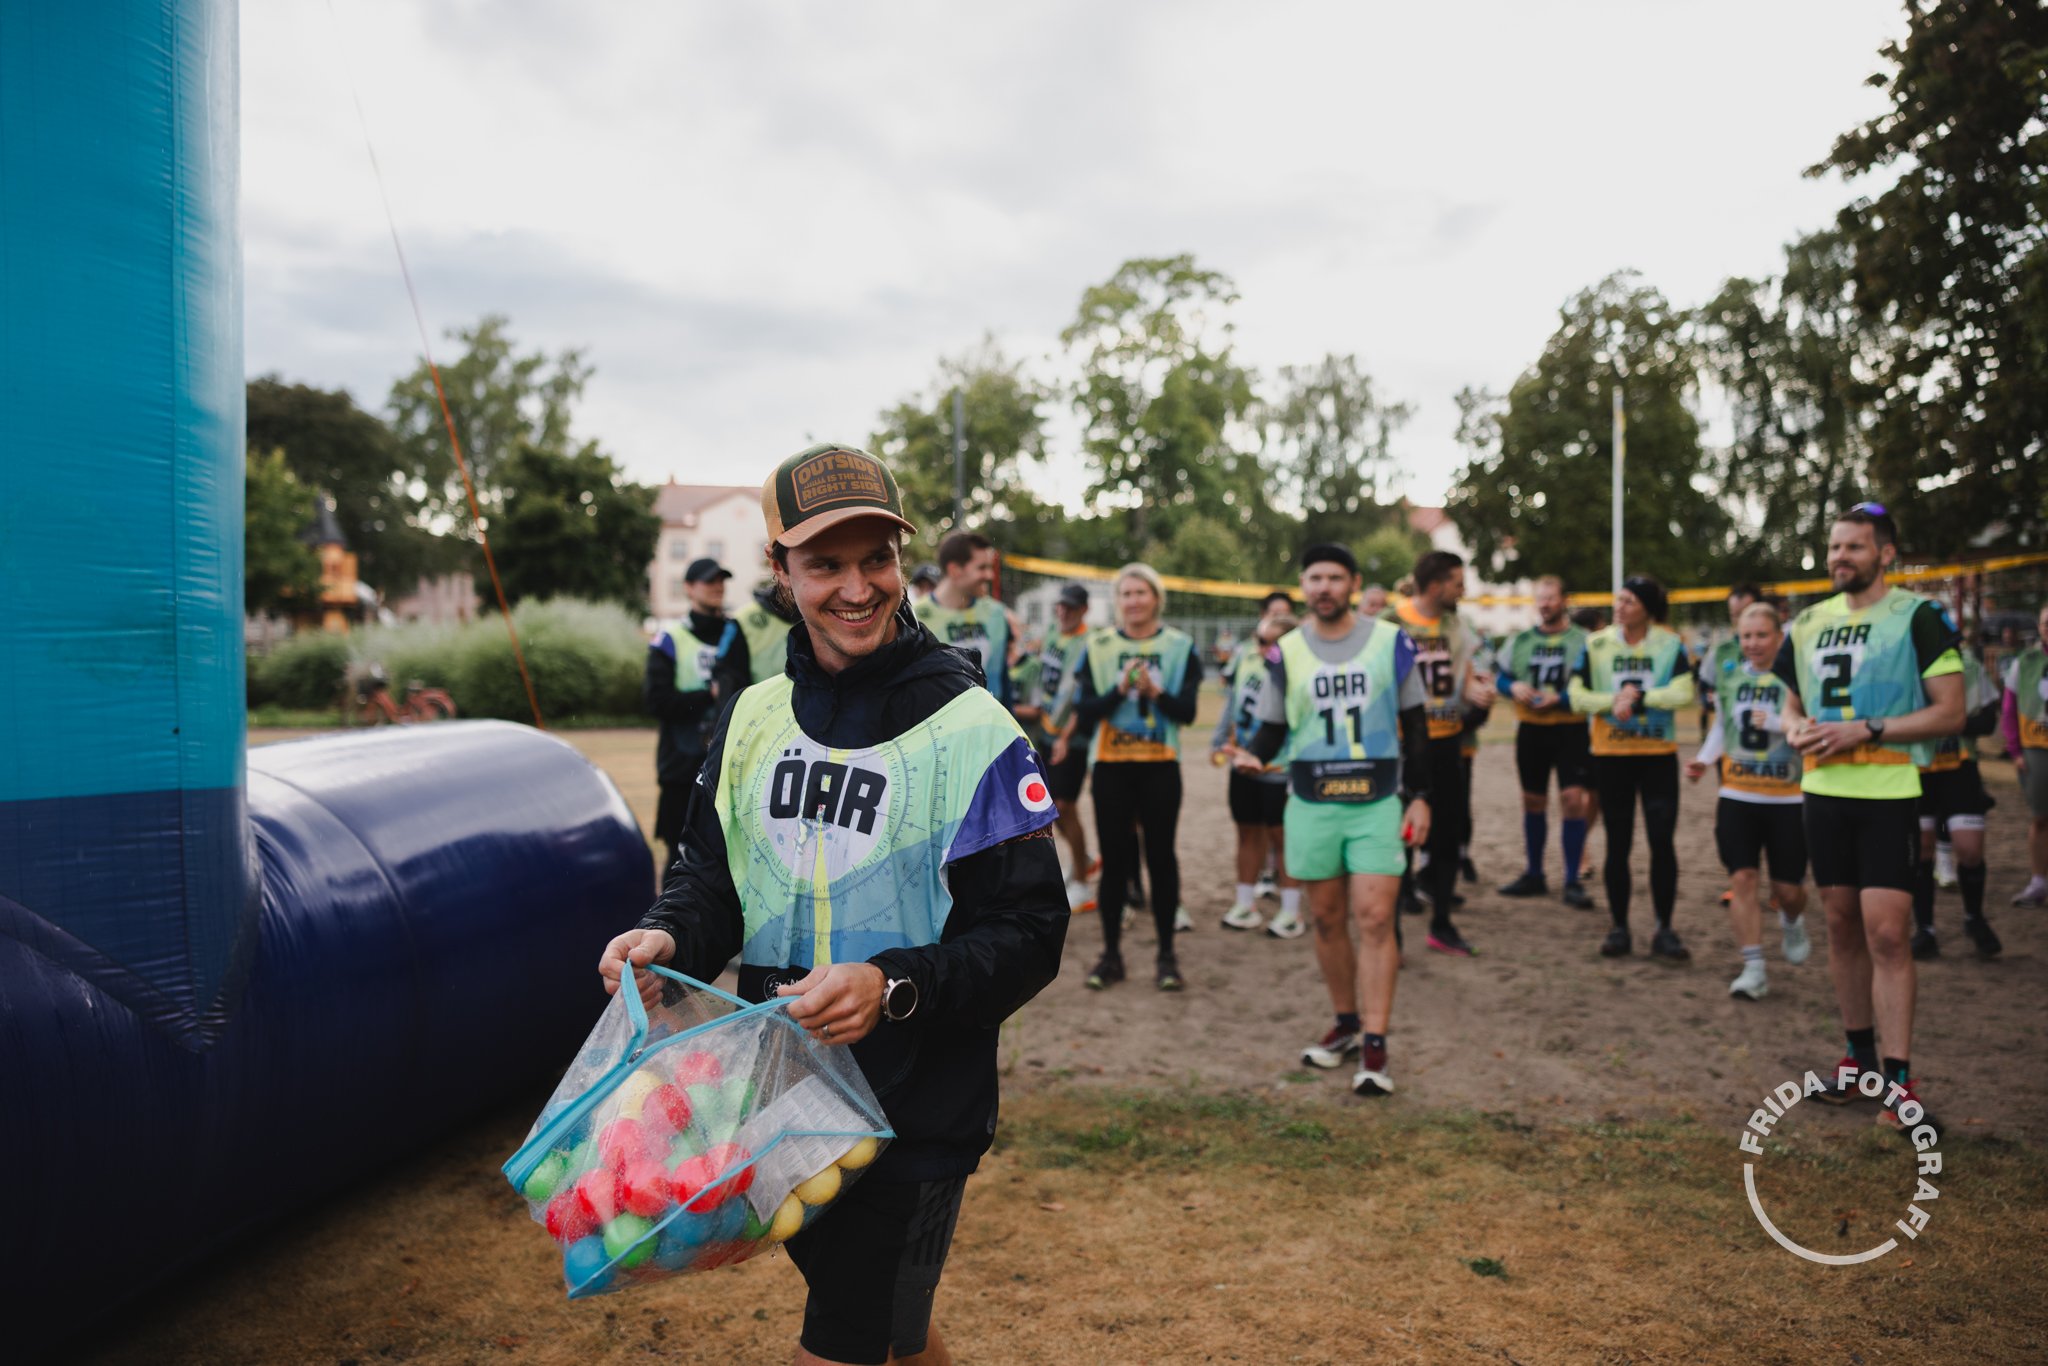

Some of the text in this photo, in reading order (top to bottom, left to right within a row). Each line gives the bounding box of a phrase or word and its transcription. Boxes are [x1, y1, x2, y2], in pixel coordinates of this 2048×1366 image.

[798, 454, 878, 484] OUTSIDE
[827, 474, 837, 482] IS
[802, 481, 847, 501] RIGHT
[851, 480, 882, 493] SIDE
[1821, 655, 1852, 708] 2
[1318, 705, 1363, 746] 11
[769, 748, 888, 836] ÖAR
